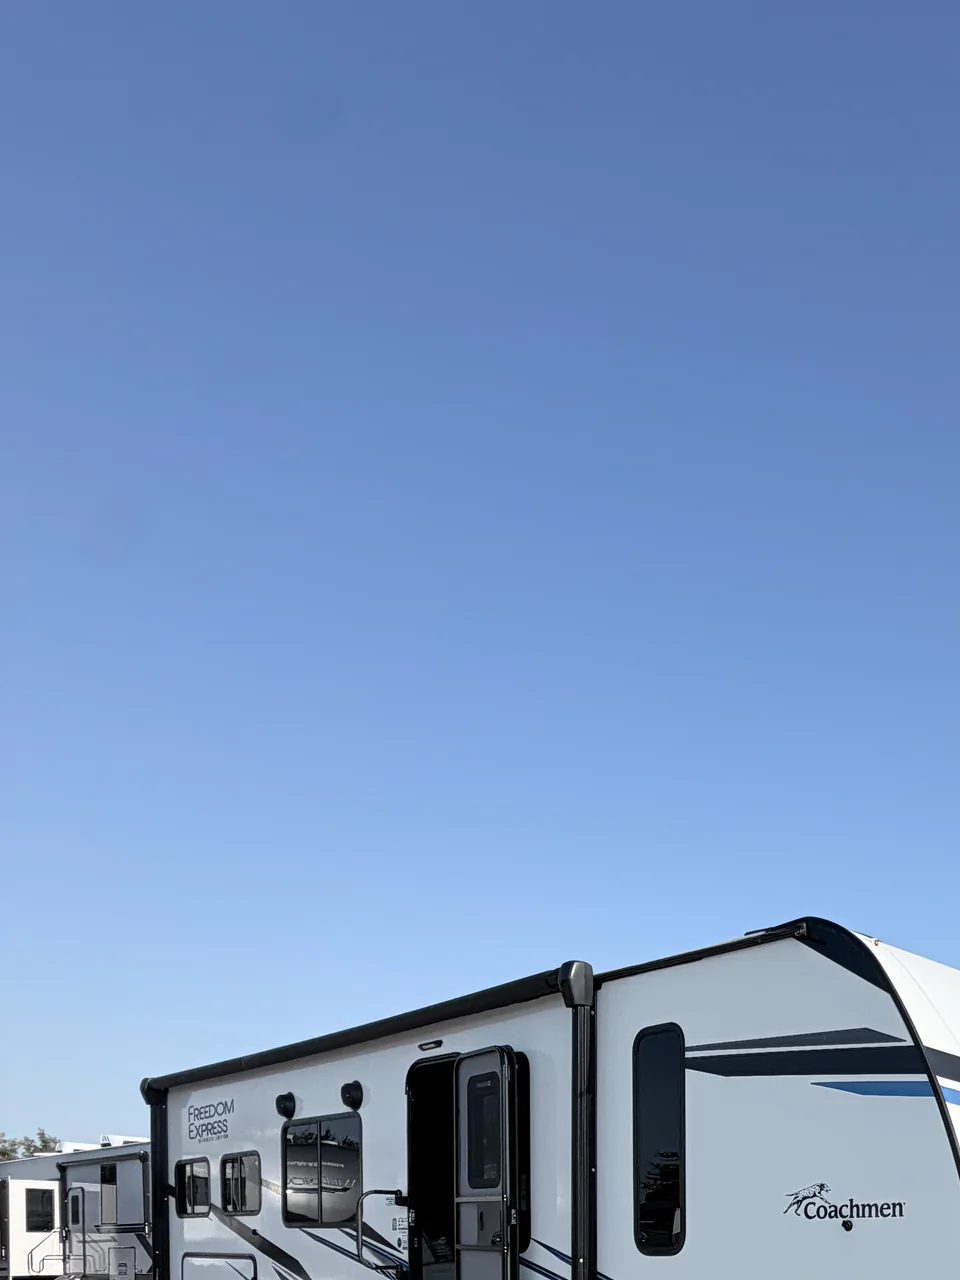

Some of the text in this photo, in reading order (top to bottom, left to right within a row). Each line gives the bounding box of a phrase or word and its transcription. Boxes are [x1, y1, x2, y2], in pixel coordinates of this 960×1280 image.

[188, 1098, 235, 1123] FREEDOM
[188, 1118, 228, 1140] EXPRESS
[803, 1198, 906, 1220] Coachmen
